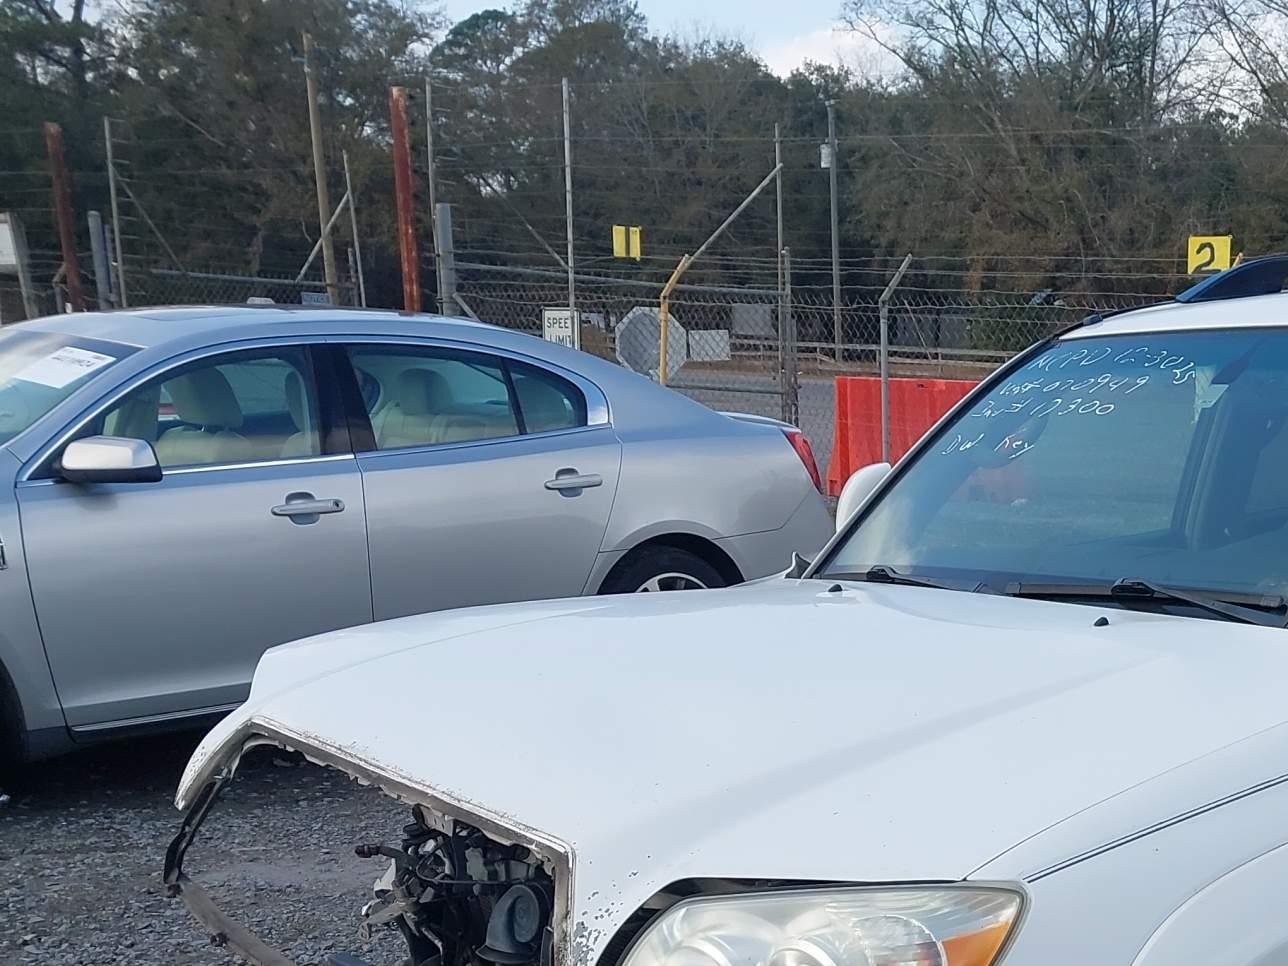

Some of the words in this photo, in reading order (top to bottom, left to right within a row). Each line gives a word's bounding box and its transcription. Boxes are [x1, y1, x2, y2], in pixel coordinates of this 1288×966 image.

[1191, 242, 1222, 274] 2
[546, 317, 569, 329] SPEE
[1030, 398, 1115, 418] 17300
